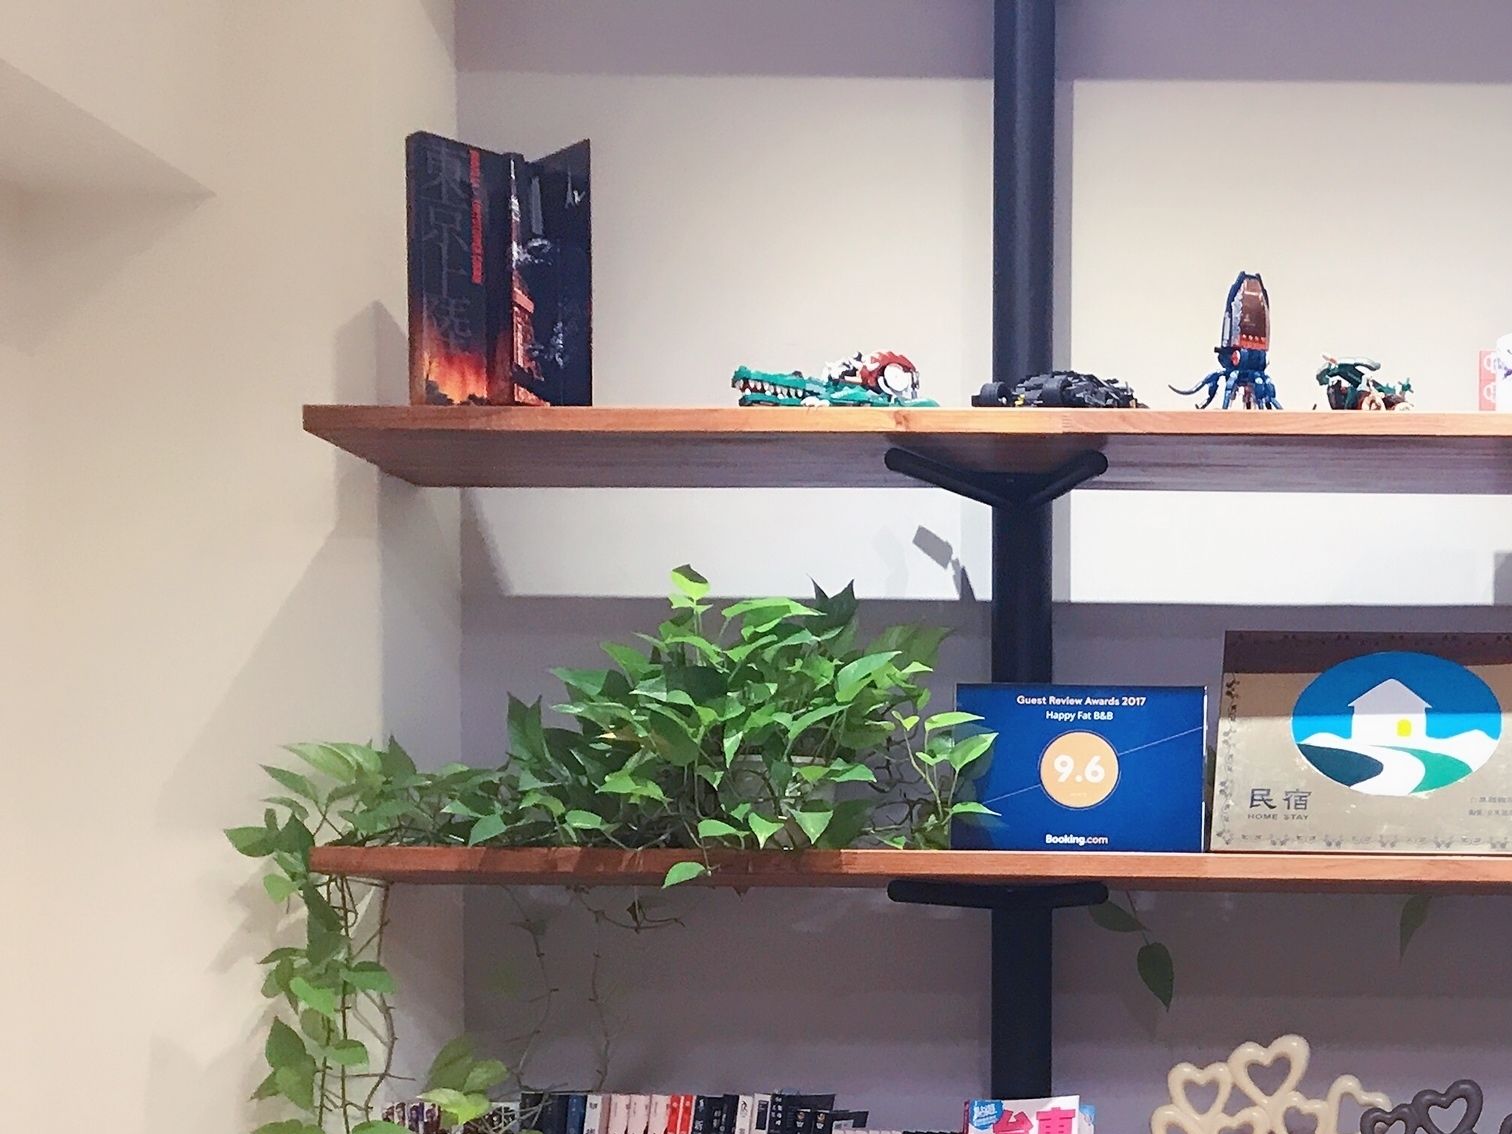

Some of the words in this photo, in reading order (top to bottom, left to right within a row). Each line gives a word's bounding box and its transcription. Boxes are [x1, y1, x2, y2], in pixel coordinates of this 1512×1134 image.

[1016, 695, 1046, 705] Guest
[1049, 696, 1083, 706] Review
[1084, 696, 1119, 706] Awards
[1121, 697, 1146, 707] 2017
[1046, 711, 1076, 722] Happy
[1077, 711, 1092, 720] Fat
[1093, 711, 1113, 721] B&B
[1053, 754, 1106, 783] 9.6
[1249, 788, 1312, 810] 民宿
[1284, 813, 1309, 821] STAY
[1045, 834, 1108, 846] Booking.com
